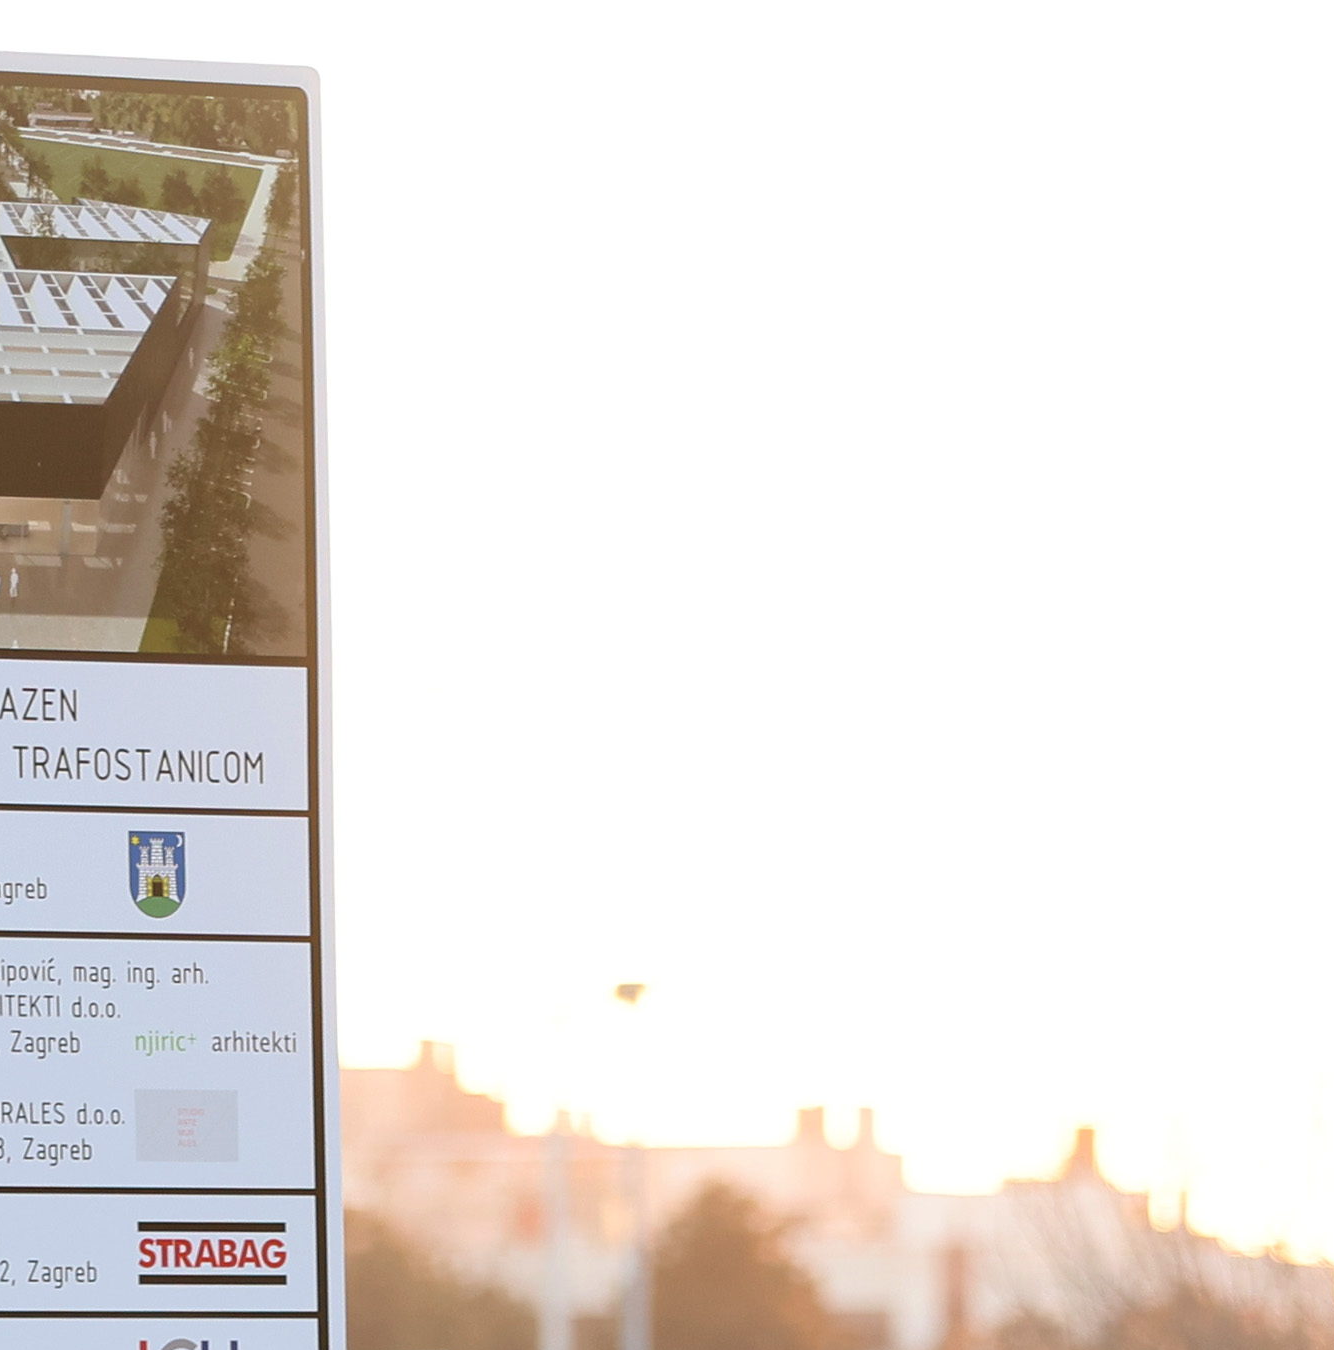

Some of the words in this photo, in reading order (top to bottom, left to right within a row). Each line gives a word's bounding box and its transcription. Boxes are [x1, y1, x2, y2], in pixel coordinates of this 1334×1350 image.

[11, 745, 264, 785] TRAFOSTANICOM
[73, 965, 117, 990] mag.
[127, 960, 160, 990] ing.
[171, 961, 209, 984] arh.
[71, 995, 121, 1019] d.o.o.
[10, 1029, 81, 1060] Zagreb
[211, 1030, 297, 1054] arhitekti
[76, 1102, 126, 1125] d.o.o.
[22, 1136, 93, 1167] Zagreb
[138, 1238, 287, 1268] STRABAG
[0, 1259, 16, 1287] 2,
[27, 1259, 98, 1290] Zagreb
